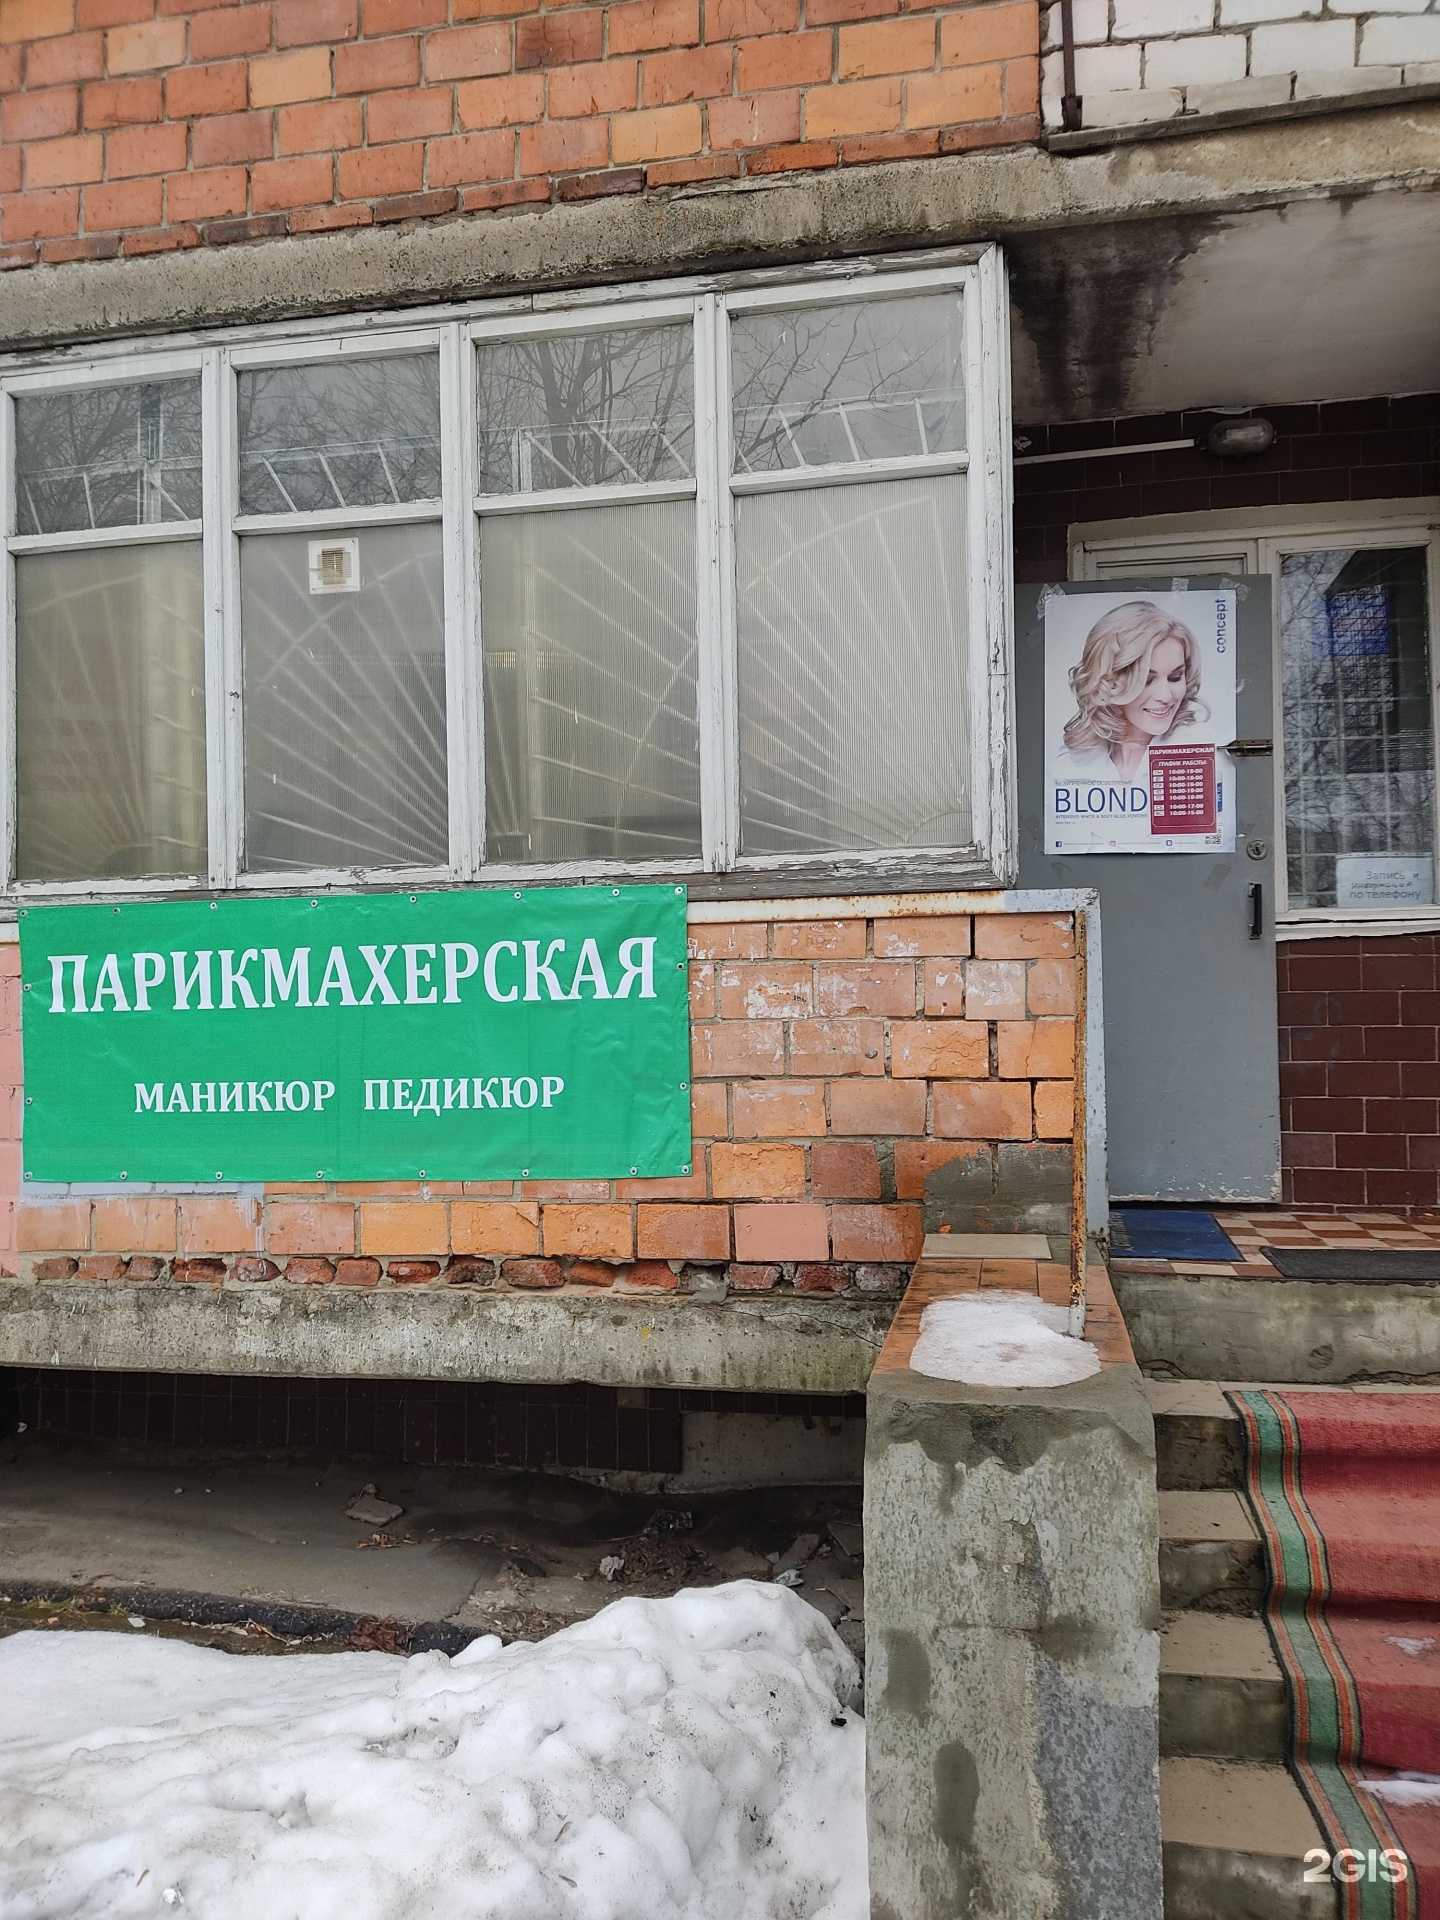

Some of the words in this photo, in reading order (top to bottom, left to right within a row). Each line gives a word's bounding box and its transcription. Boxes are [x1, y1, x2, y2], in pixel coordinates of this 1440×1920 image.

[1215, 599, 1228, 654] concept
[1055, 787, 1148, 813] BLOND
[47, 937, 658, 1014] ПАРИКМАХЕРСКАЯ
[134, 1080, 336, 1114] МАНИКЮР
[363, 1075, 565, 1118] ПЕДИКЮР
